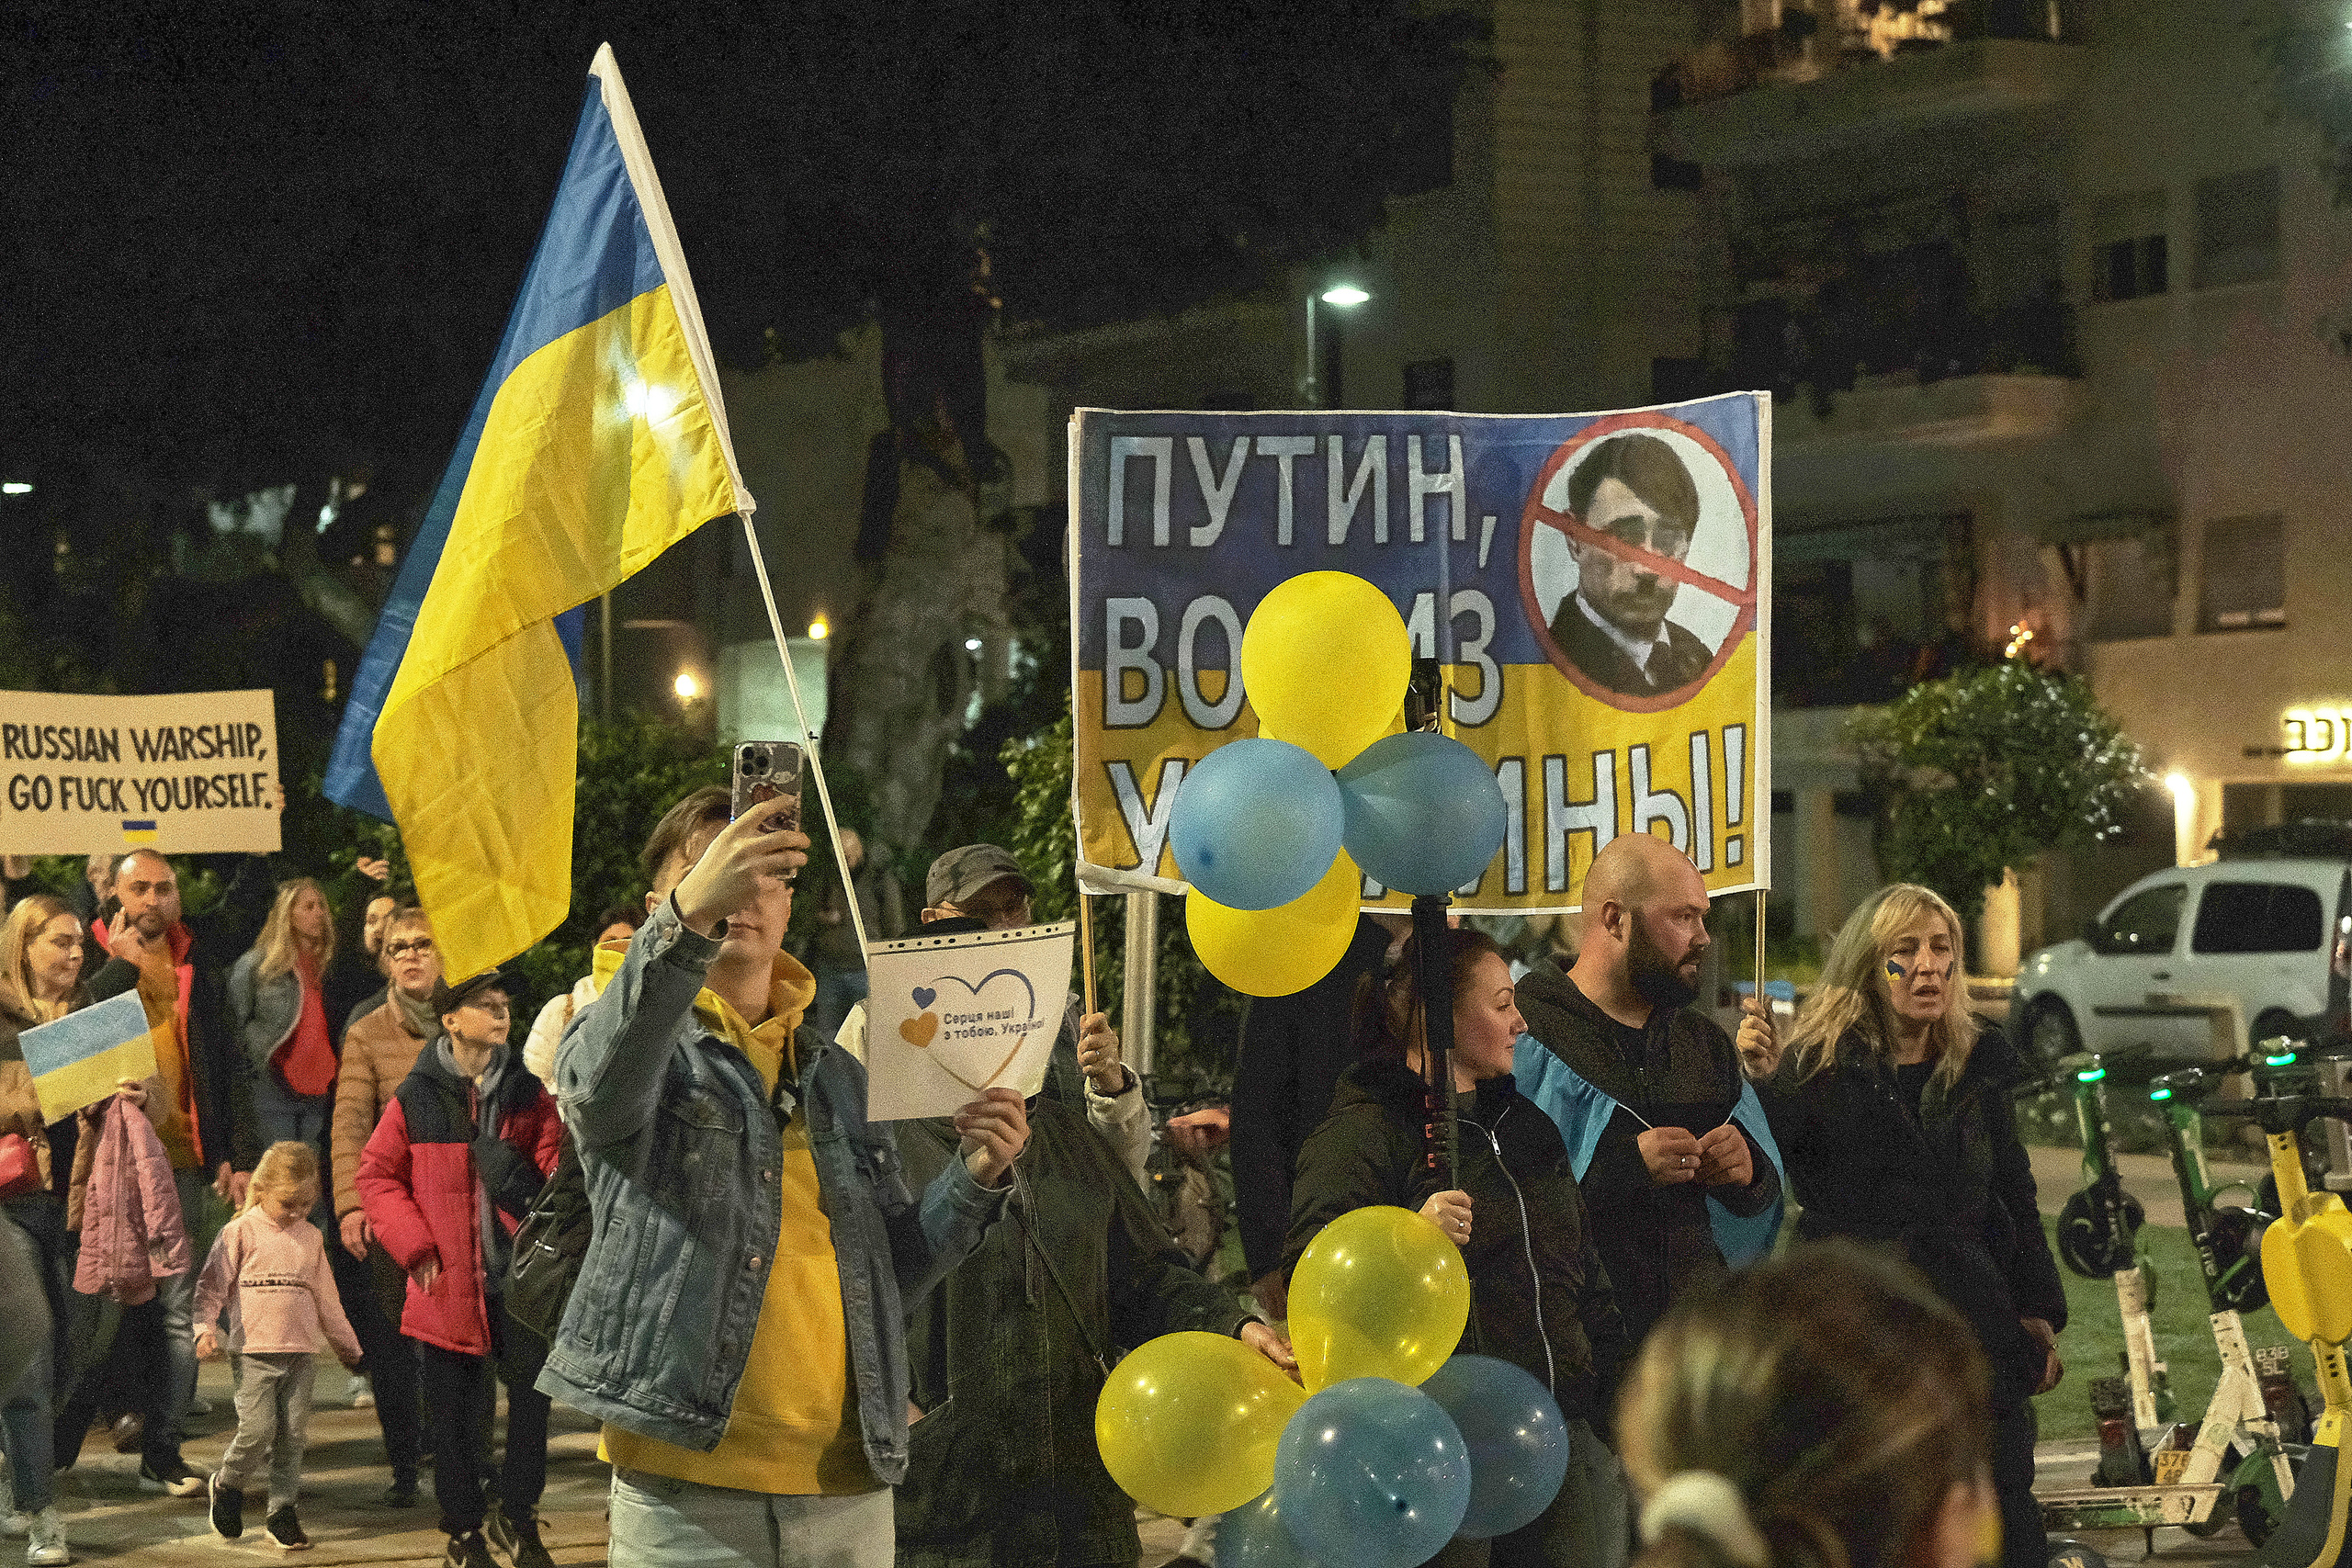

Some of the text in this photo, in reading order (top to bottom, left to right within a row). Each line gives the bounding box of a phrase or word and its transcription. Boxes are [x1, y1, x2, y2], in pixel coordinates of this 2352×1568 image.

[1107, 434, 1497, 569] ПУТИН,
[1104, 594, 1245, 728] ВО
[2, 721, 267, 762] RUSSIAN WARSHIP,
[8, 772, 273, 812] GO FUCK YOURSELF.
[944, 1011, 983, 1026] Серця
